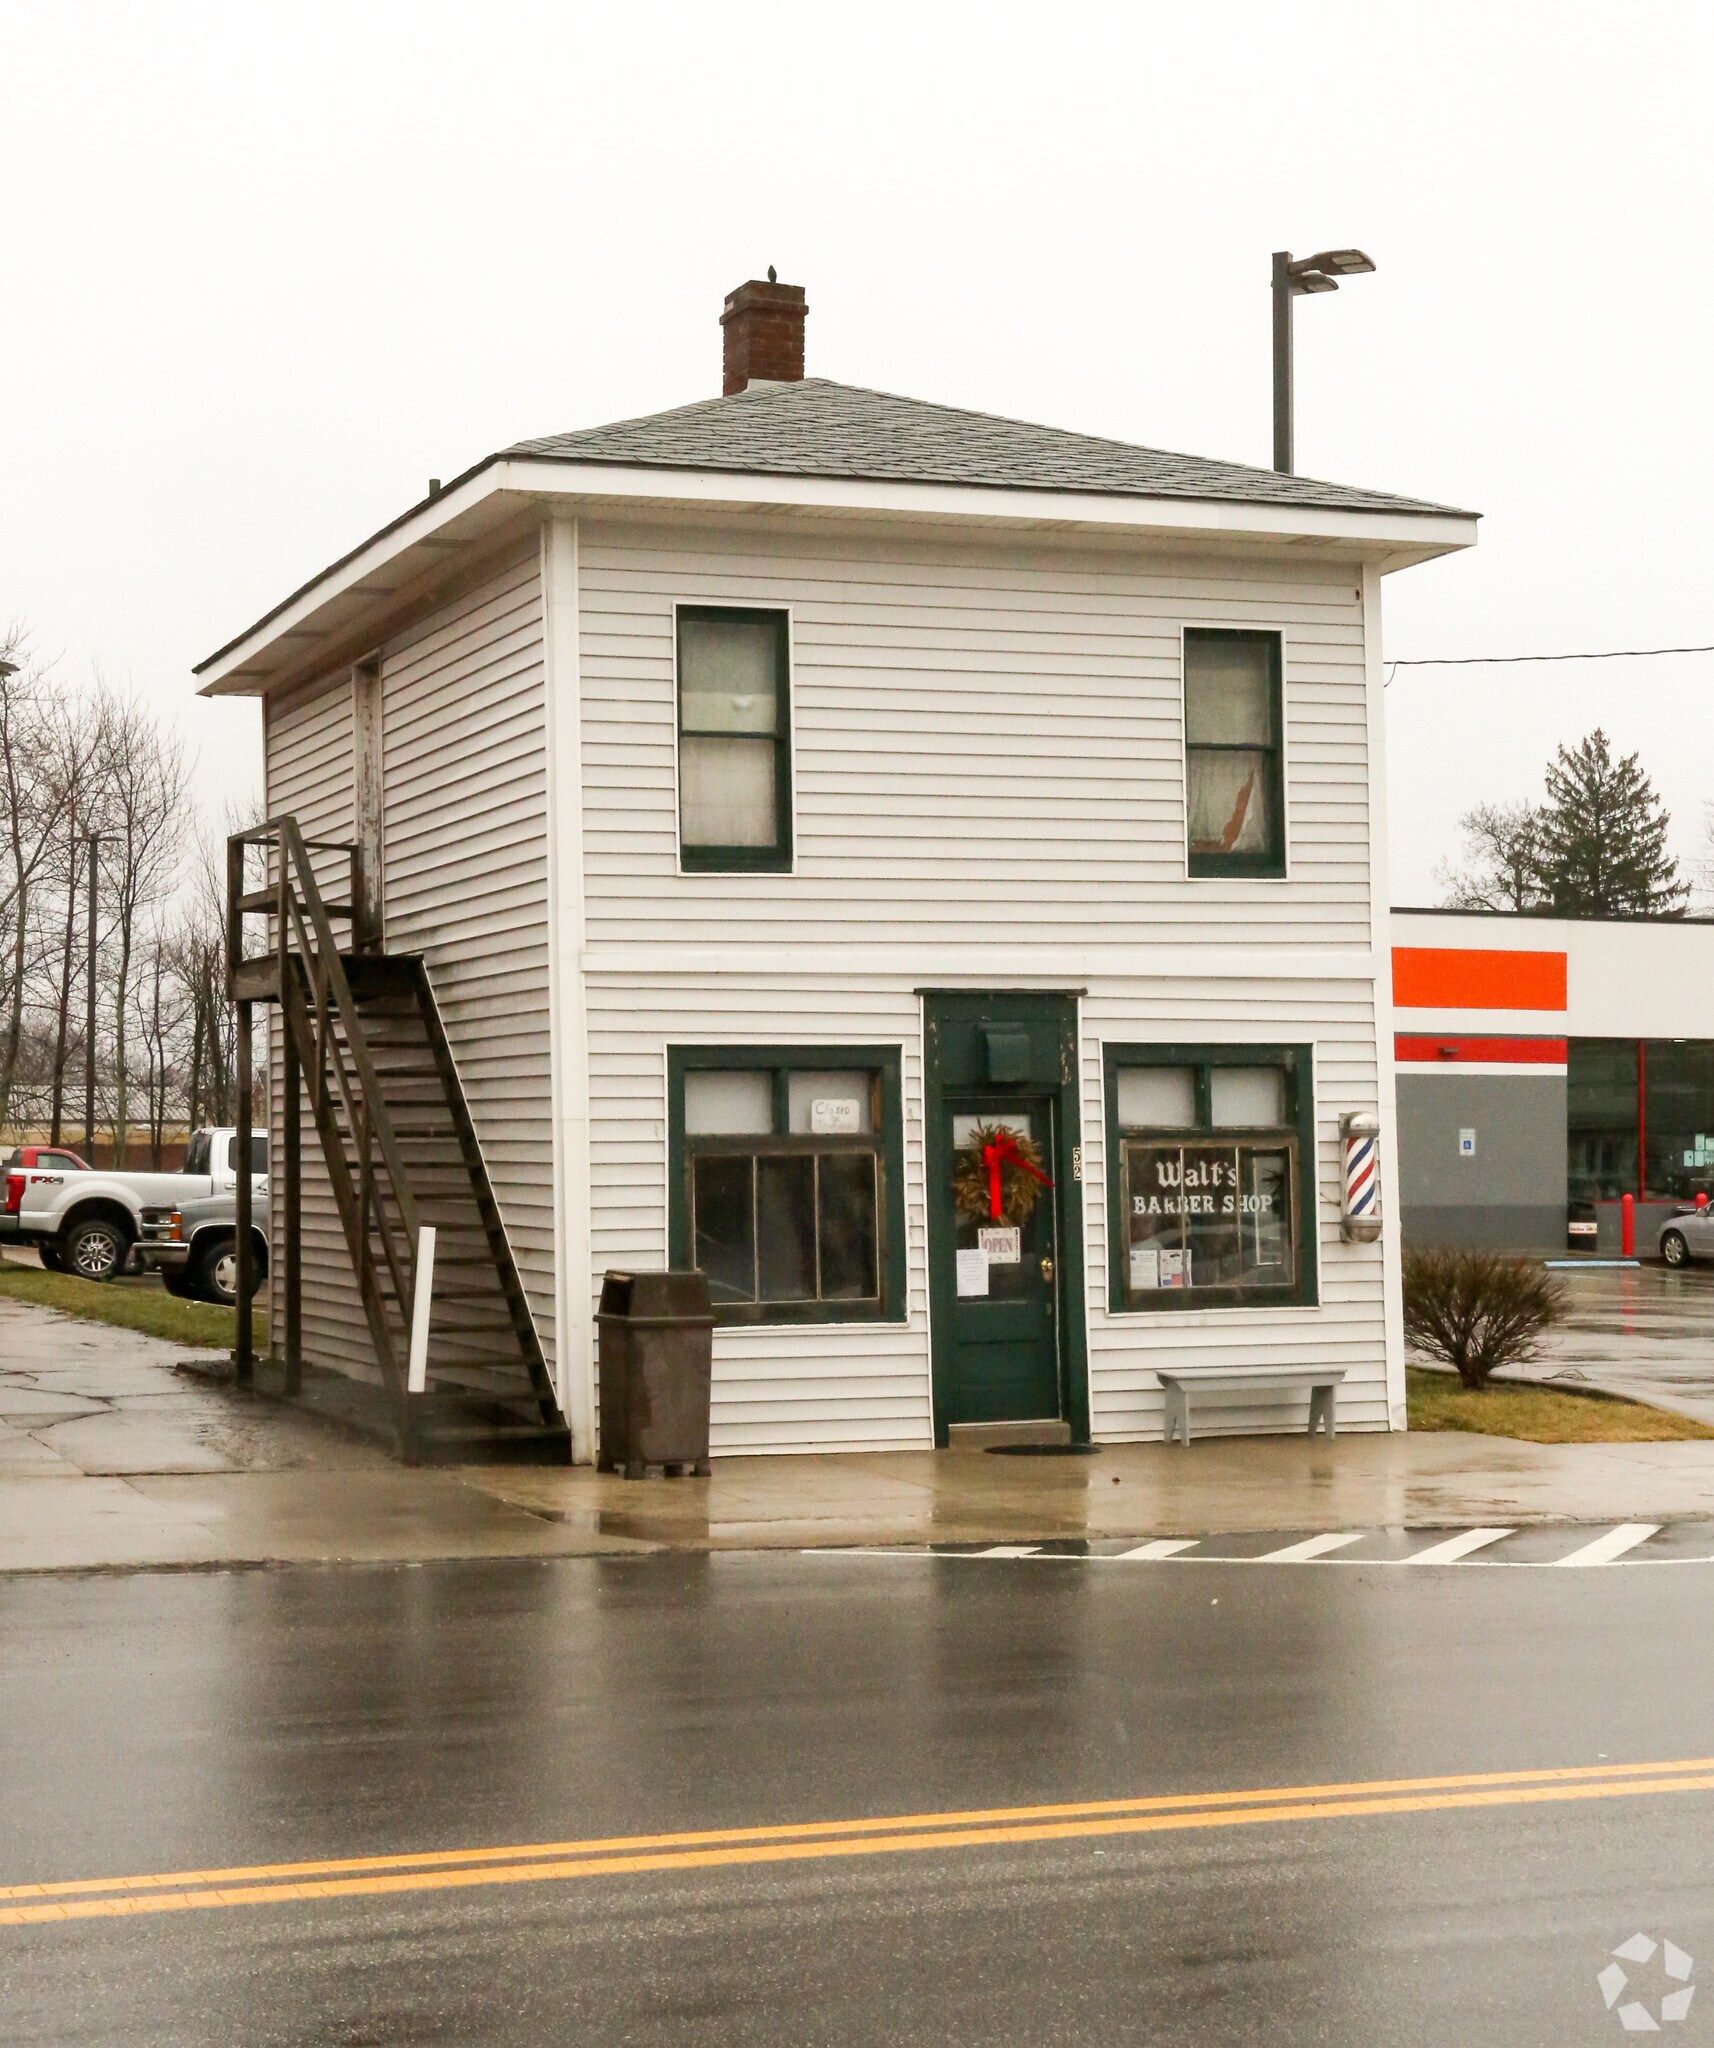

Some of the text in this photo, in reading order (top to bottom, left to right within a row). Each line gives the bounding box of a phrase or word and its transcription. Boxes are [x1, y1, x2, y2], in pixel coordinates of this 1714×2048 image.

[31, 1176, 64, 1185] FX4
[1155, 1160, 1237, 1188] Walt's
[1133, 1194, 1273, 1214] BARBER SHOP
[984, 1237, 1013, 1253] OPEN
